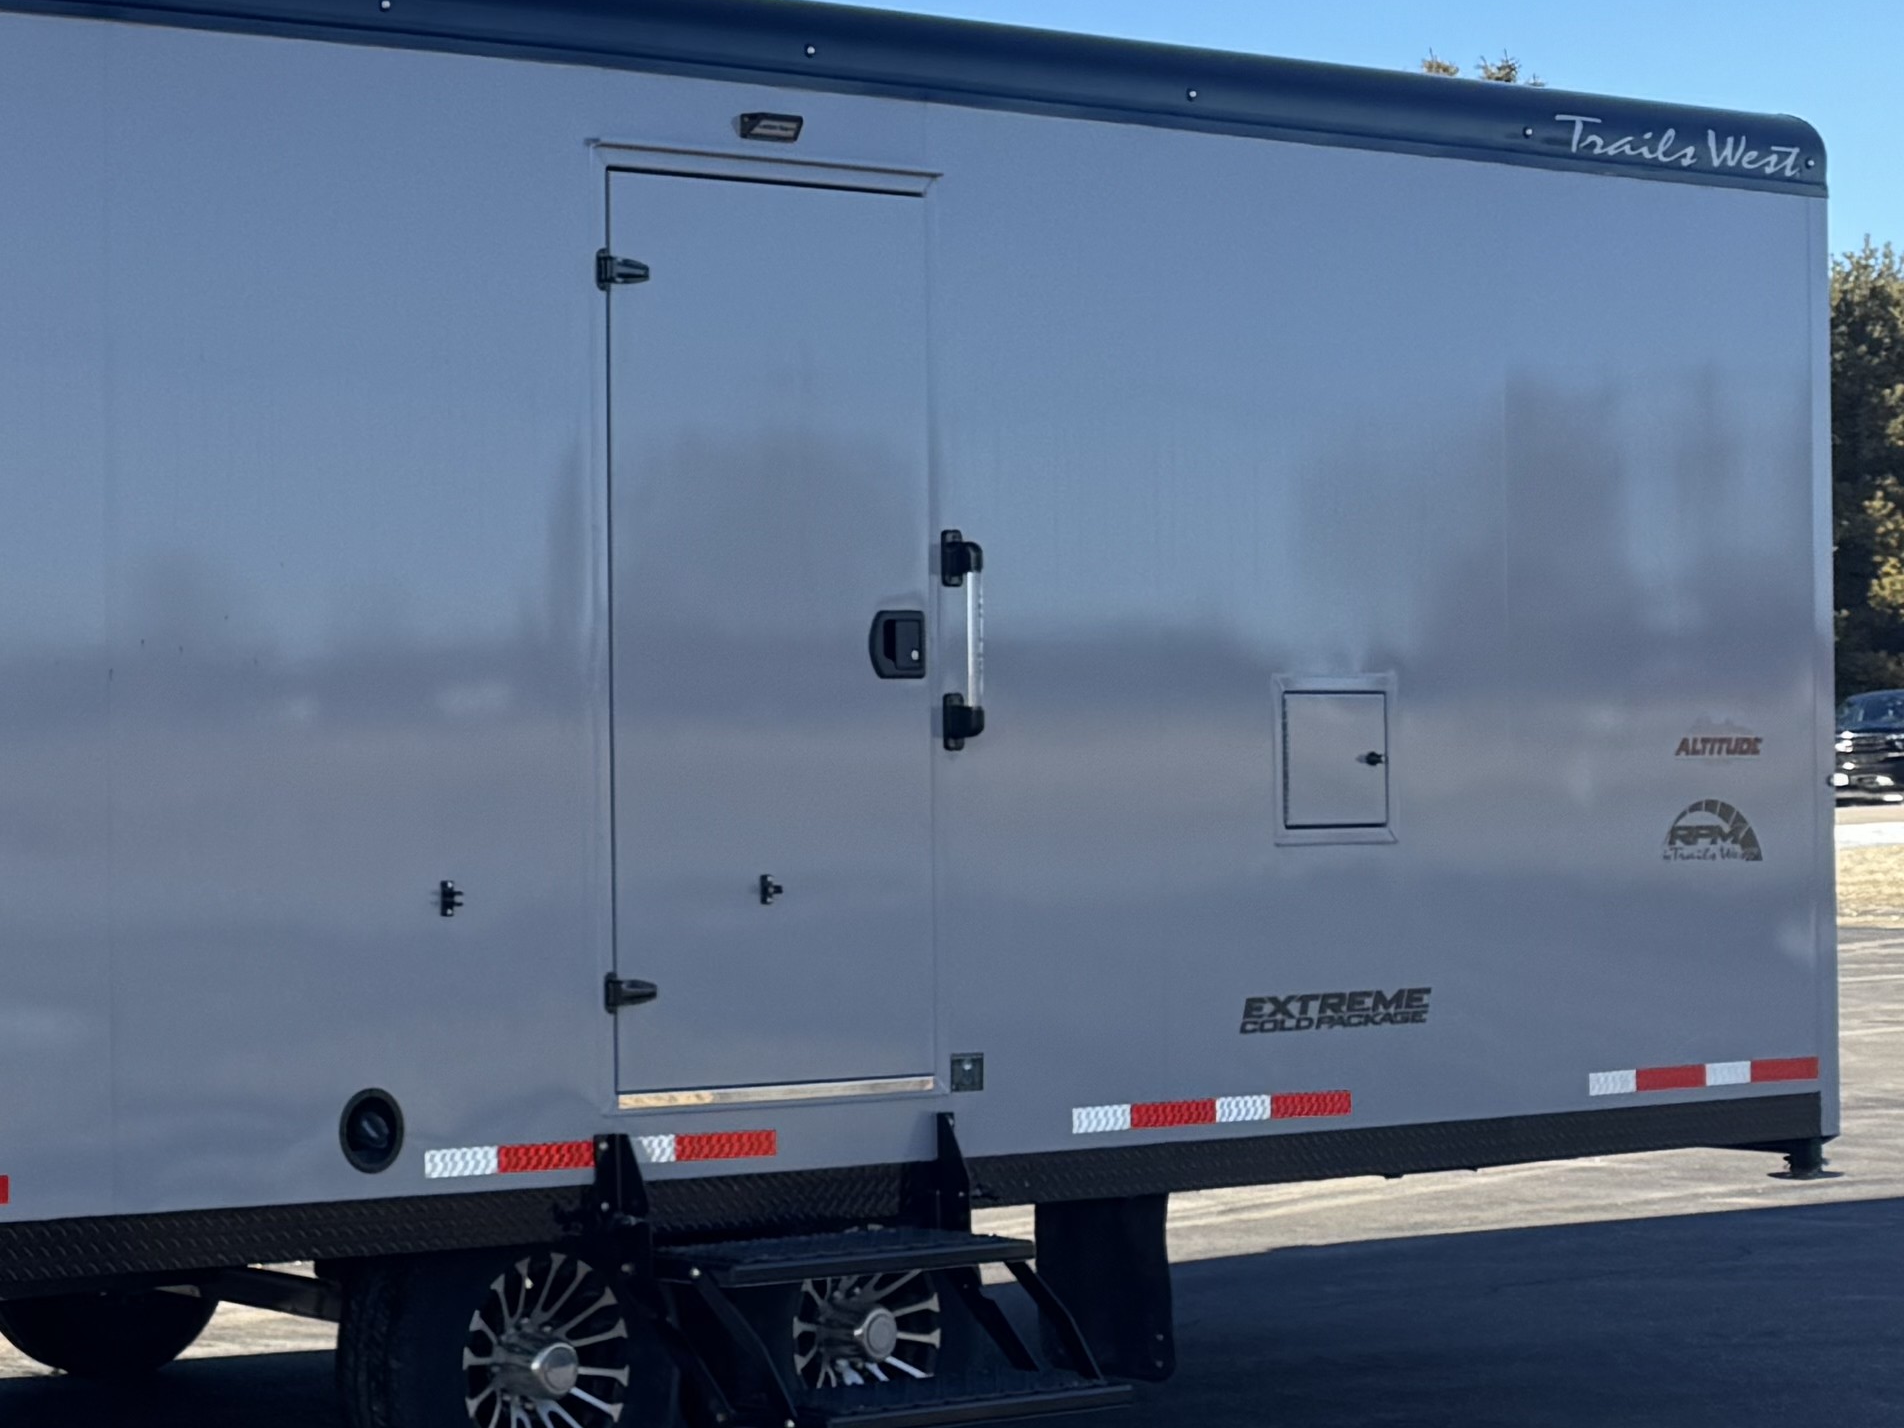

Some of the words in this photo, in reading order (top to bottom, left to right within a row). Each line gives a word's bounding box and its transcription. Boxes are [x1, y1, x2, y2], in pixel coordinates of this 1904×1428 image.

[1555, 114, 1697, 167] Trails
[1707, 129, 1800, 177] West
[1675, 736, 1763, 756] ALTITUDE
[1668, 825, 1741, 845] RPM
[1243, 987, 1432, 1019] EXTREME
[1240, 1016, 1314, 1034] COLD
[1315, 1010, 1428, 1030] PACKAGE
